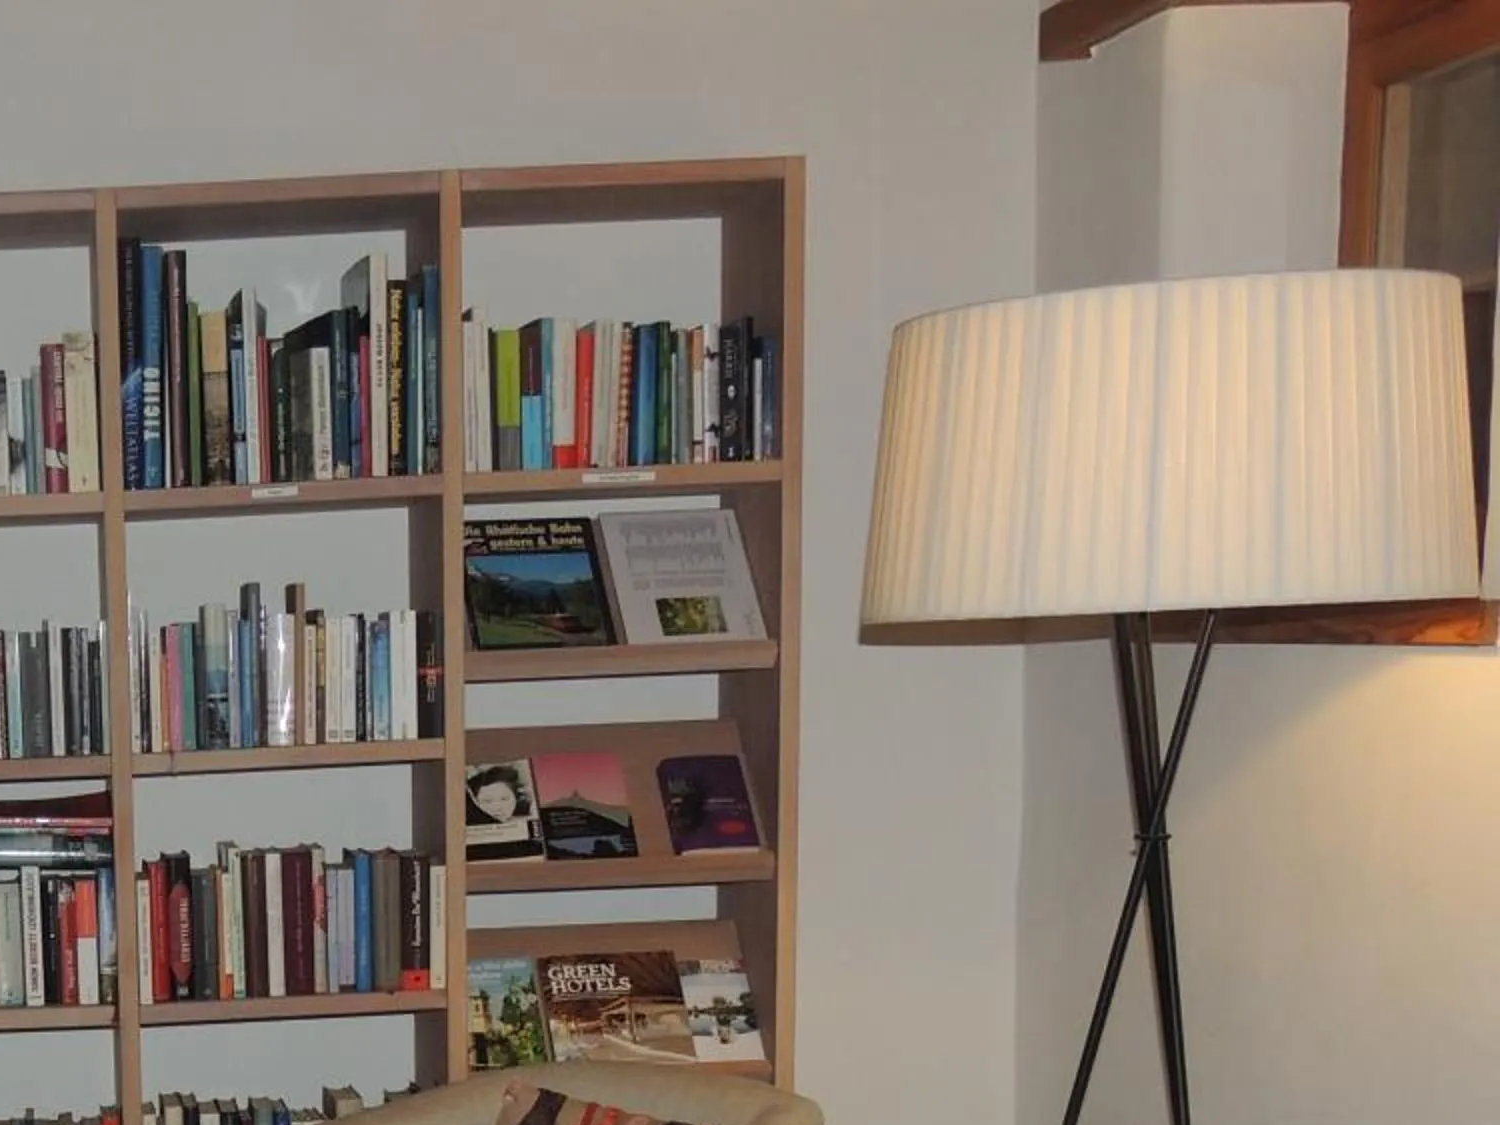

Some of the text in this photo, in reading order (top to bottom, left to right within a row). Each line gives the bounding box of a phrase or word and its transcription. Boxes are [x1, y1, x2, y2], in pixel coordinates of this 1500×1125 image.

[143, 367, 161, 439] TICINO
[549, 521, 583, 534] Bahn
[551, 534, 585, 547] heute
[547, 963, 616, 979] GREEN
[551, 977, 632, 995] HOTELS
